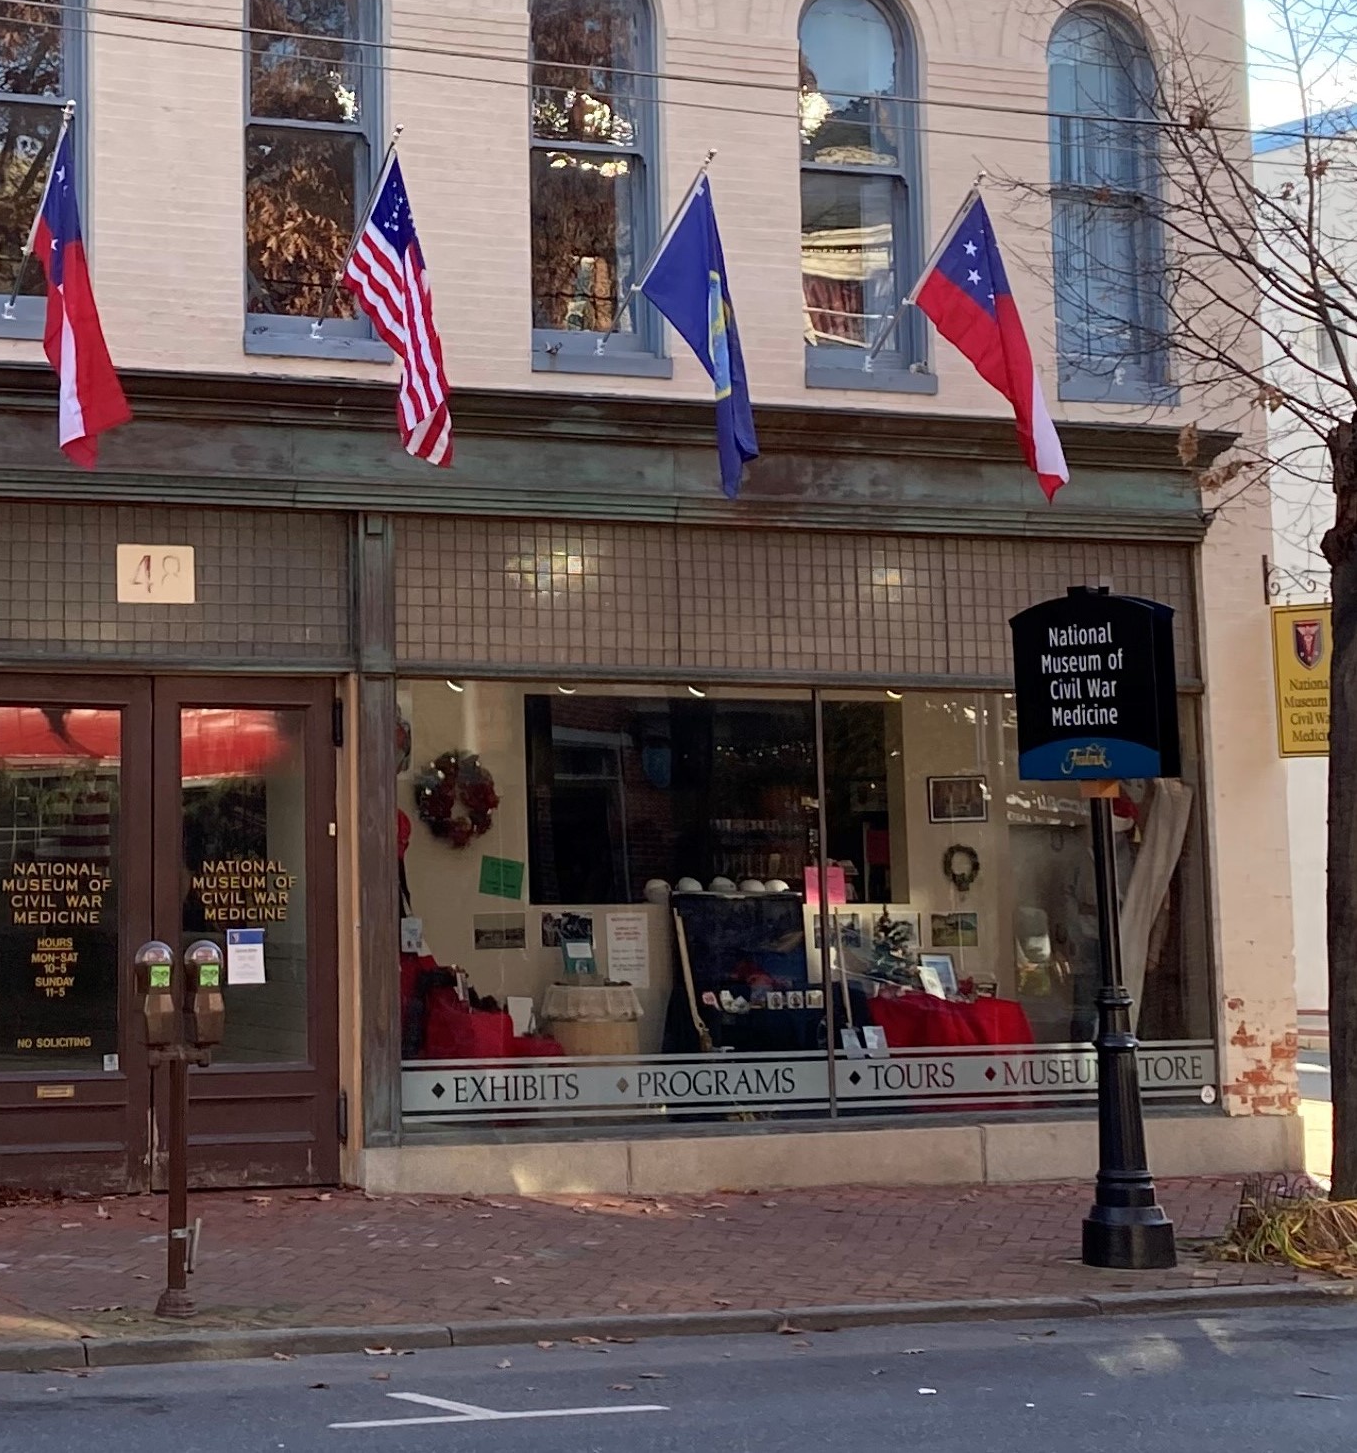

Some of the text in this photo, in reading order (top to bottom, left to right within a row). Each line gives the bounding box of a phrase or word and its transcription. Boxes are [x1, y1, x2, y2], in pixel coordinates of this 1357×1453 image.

[1048, 621, 1113, 647] National
[1041, 647, 1124, 674] Museum of
[1050, 677, 1118, 700] Civil War
[1289, 678, 1330, 691] Nationa
[1284, 696, 1328, 708] Museum
[1052, 703, 1118, 726] Medicine
[1290, 712, 1331, 725] Civil Wa
[1292, 729, 1330, 742] Medici
[13, 862, 101, 876] NATIONAL
[202, 860, 287, 873] NATIONAL
[2, 879, 112, 892] MUSEUM OF
[193, 876, 298, 889] MUSEUM OF
[11, 895, 102, 908] CIVIL WAR
[202, 892, 289, 904] CIVIL WAR
[13, 911, 100, 924] MEDICINE
[204, 907, 287, 921] MEDICINE
[37, 937, 73, 949] HOURS
[31, 952, 78, 964] MON-SAT
[44, 963, 66, 974] 10-5
[35, 976, 75, 987] SUNDAY
[45, 987, 66, 997] 11-5
[17, 1037, 92, 1048] NO SOLICITING
[454, 1053, 1204, 1103] EXHIBITS PROGRAMS TOURS MUSEU TORE
